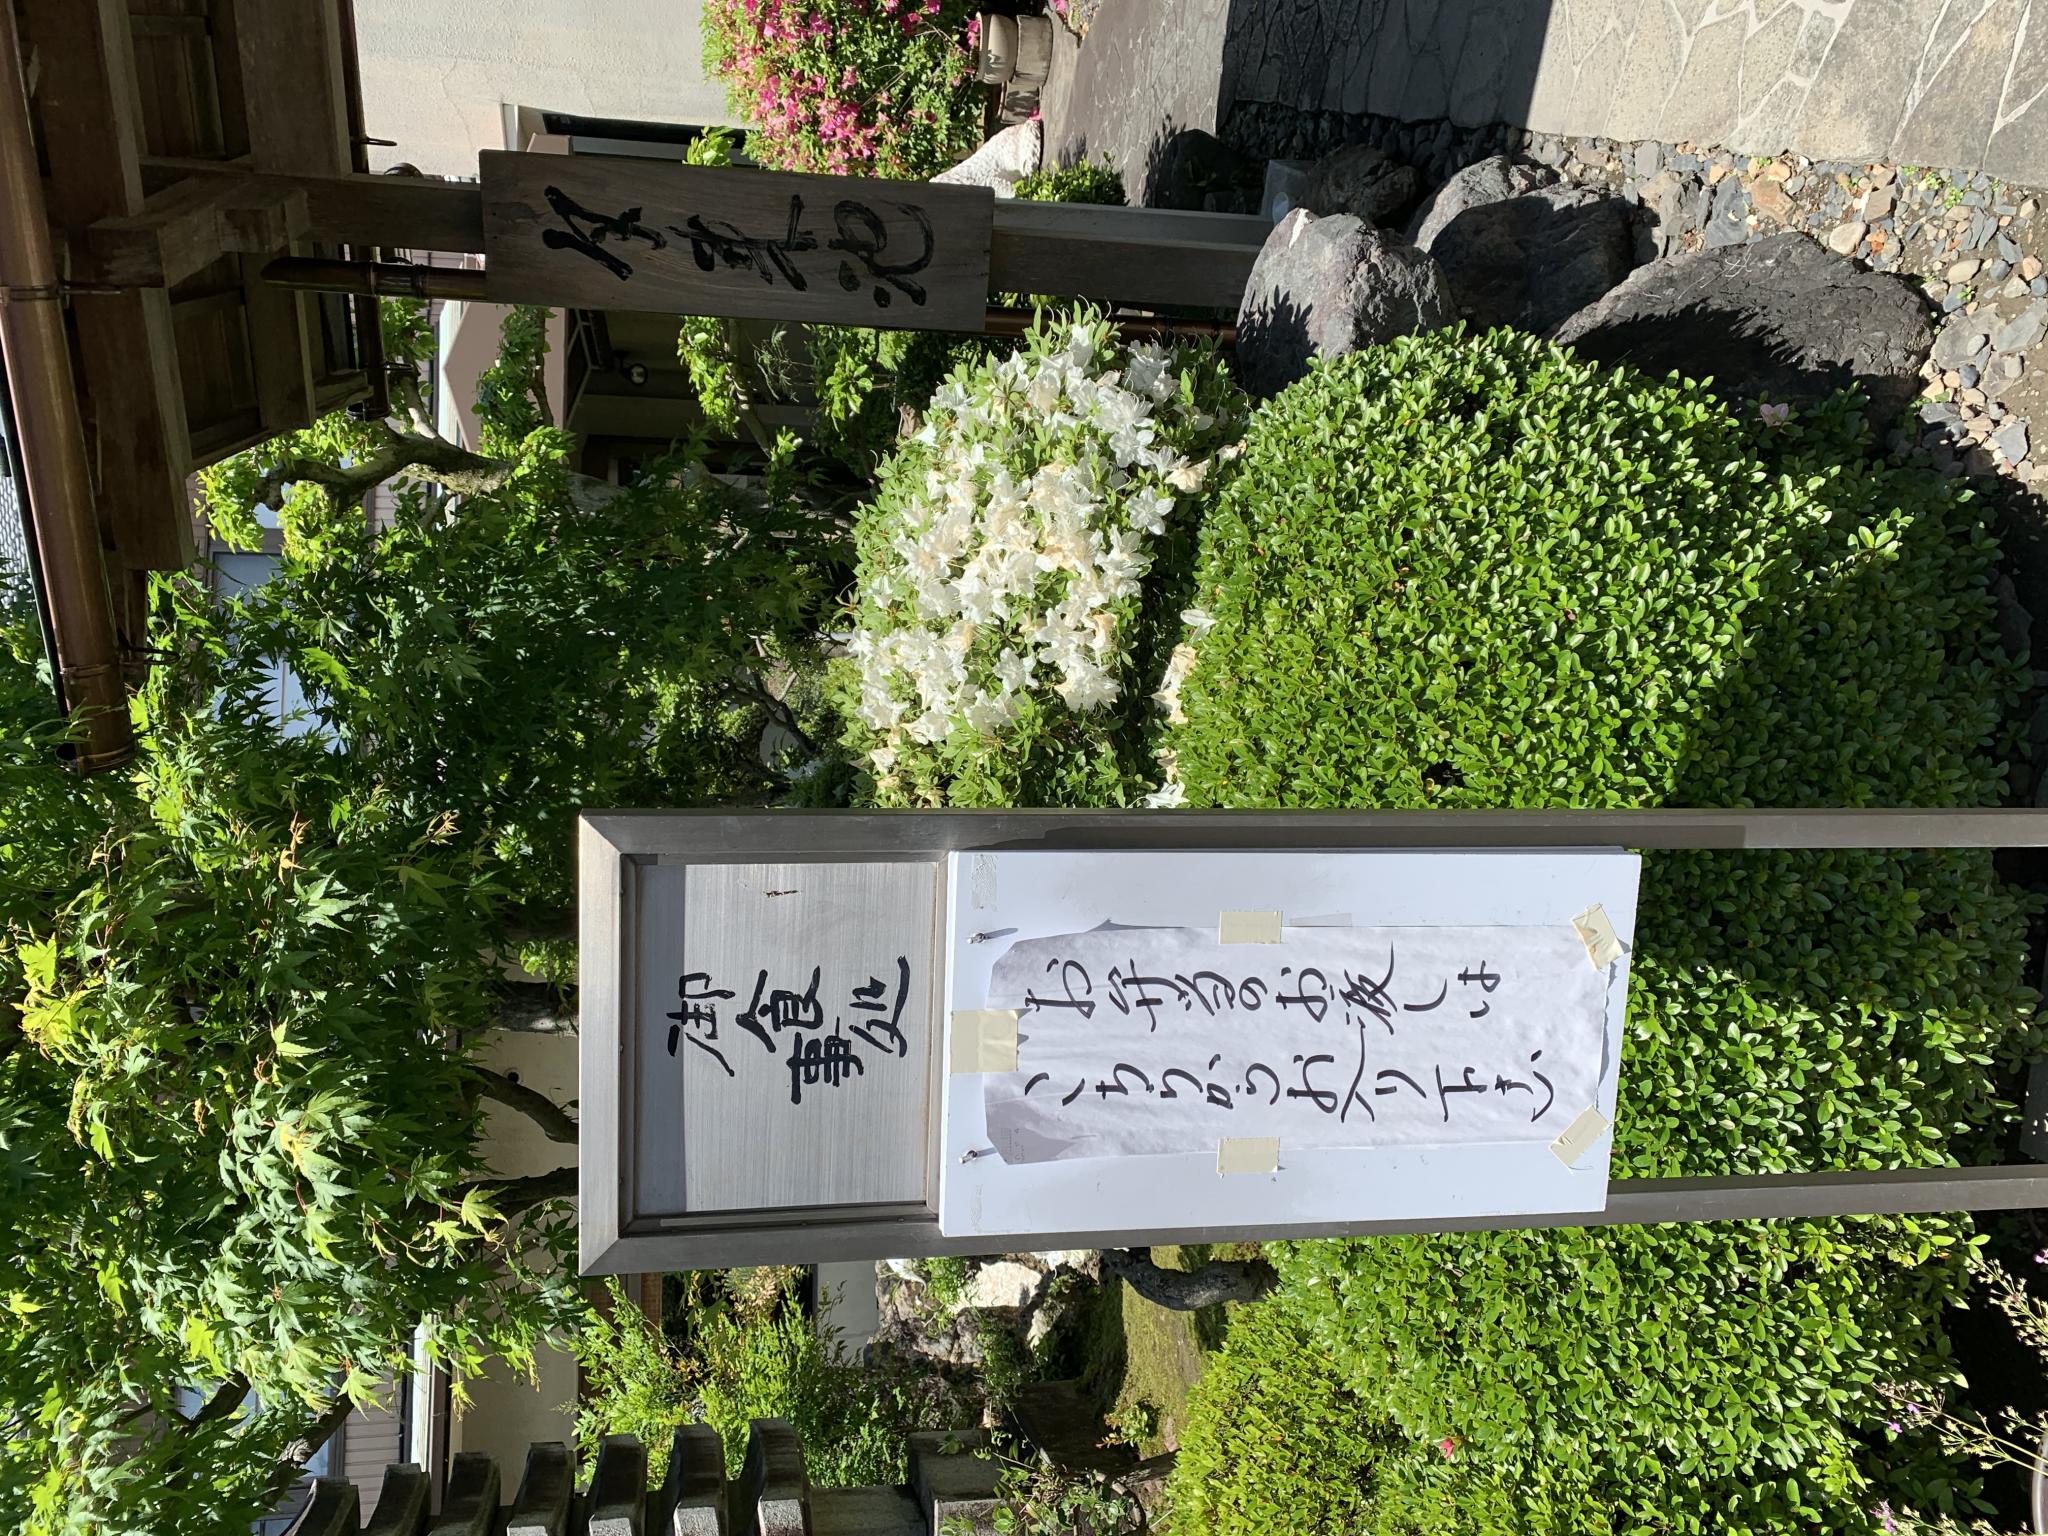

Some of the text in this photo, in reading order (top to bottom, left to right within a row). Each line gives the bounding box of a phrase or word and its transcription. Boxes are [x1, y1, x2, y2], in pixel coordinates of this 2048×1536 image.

[1023, 941, 1502, 1033] お弁当のお渡しは
[1023, 1020, 1563, 1124] こちらからお入り下さい
